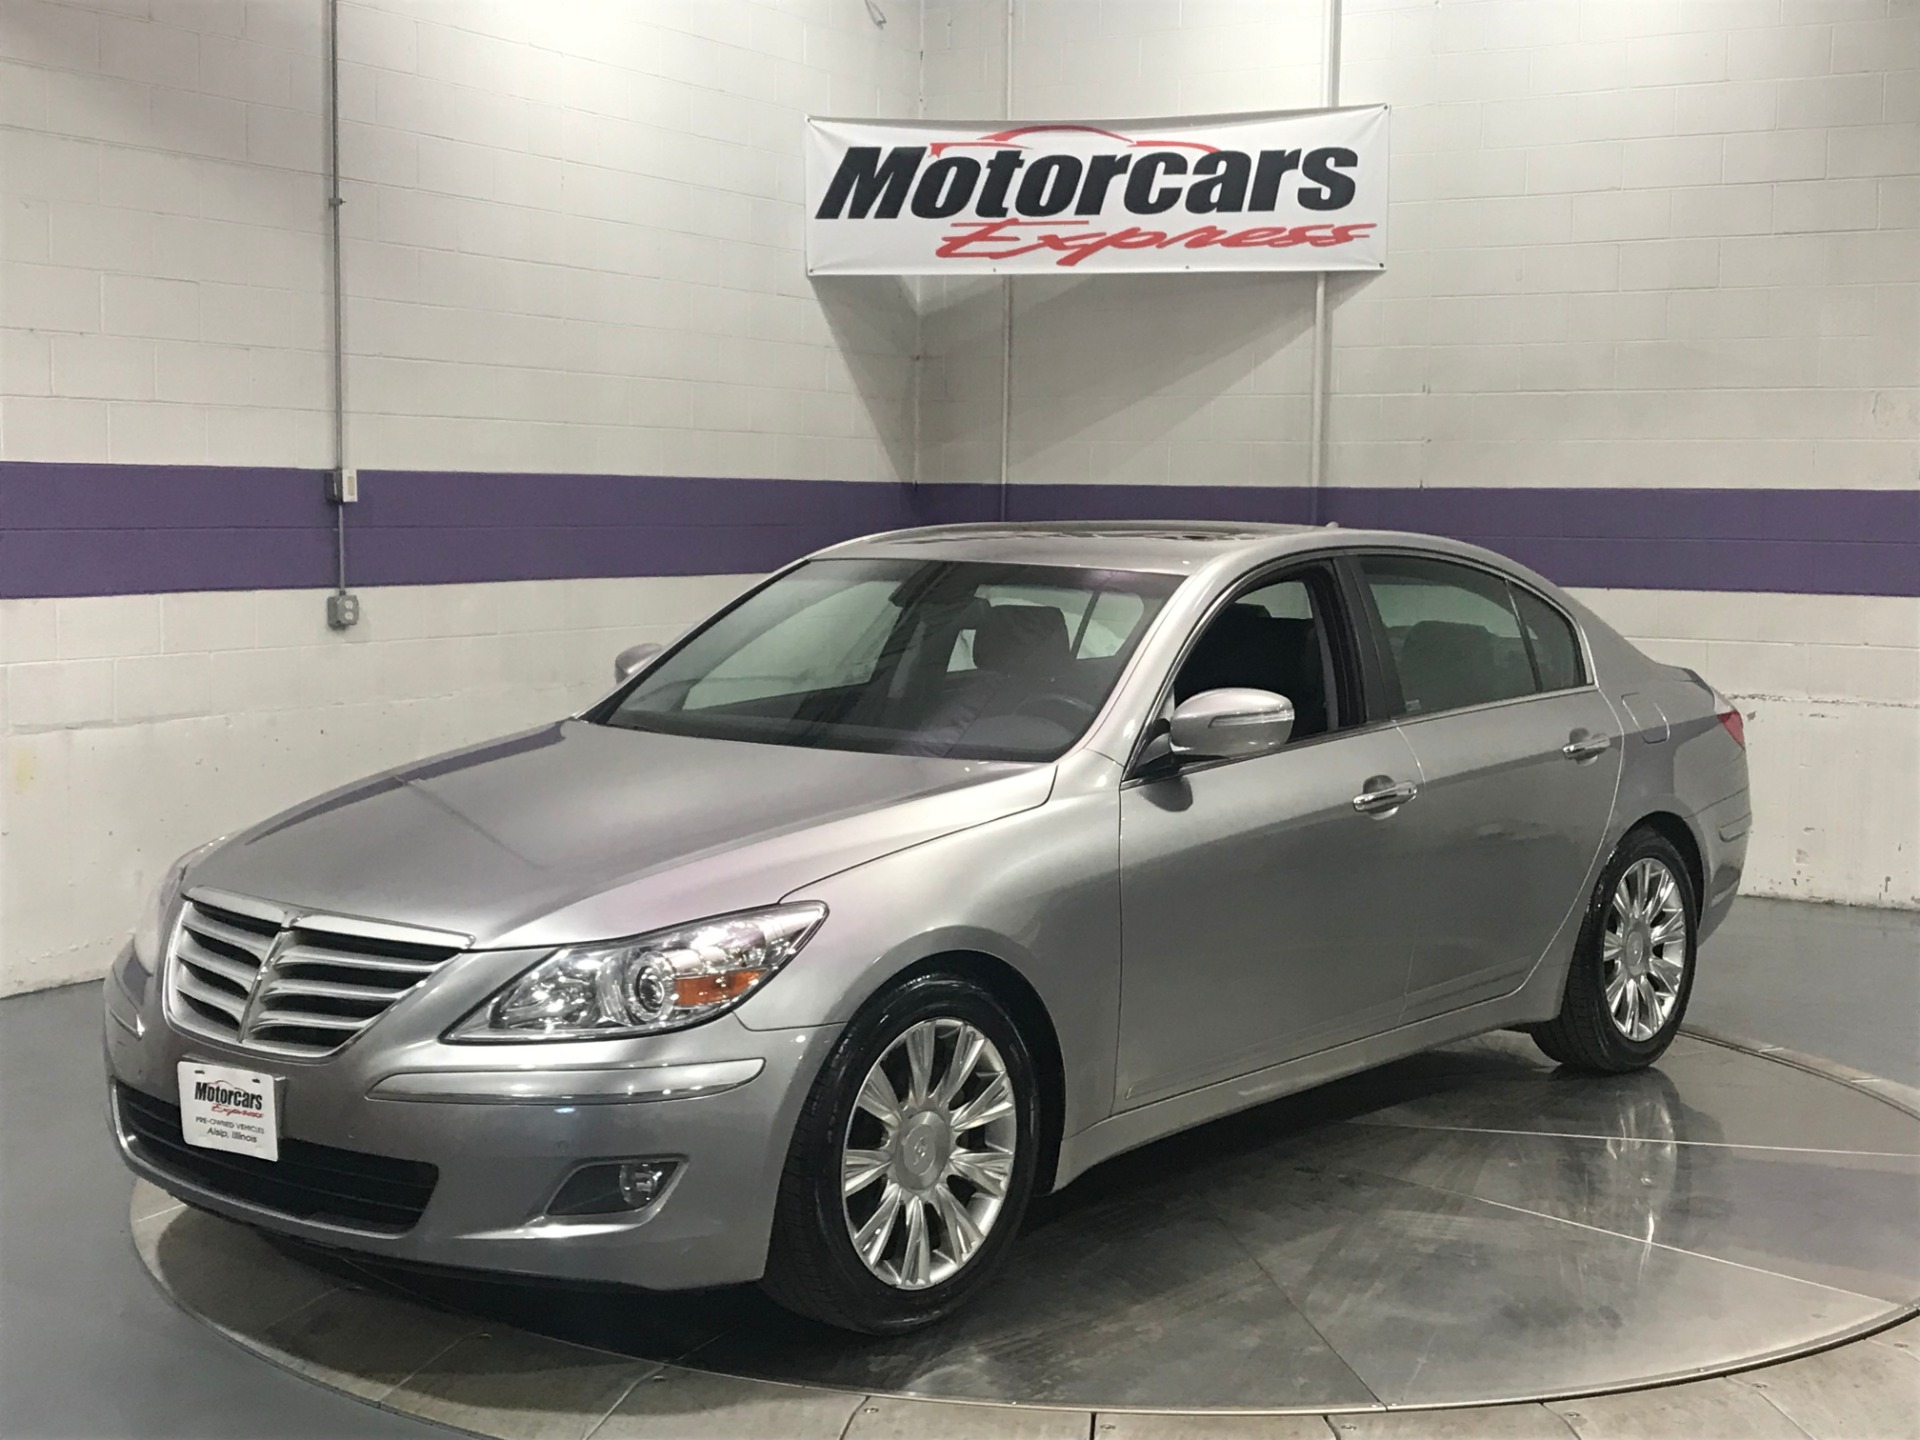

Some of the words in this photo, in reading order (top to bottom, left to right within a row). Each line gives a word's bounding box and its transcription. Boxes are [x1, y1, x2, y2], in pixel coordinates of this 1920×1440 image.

[815, 146, 1358, 219] Motorcars
[935, 217, 1376, 266] Express
[194, 1082, 263, 1110] Motorcars
[211, 1103, 264, 1118] Express
[232, 1131, 257, 1143] Illinois
